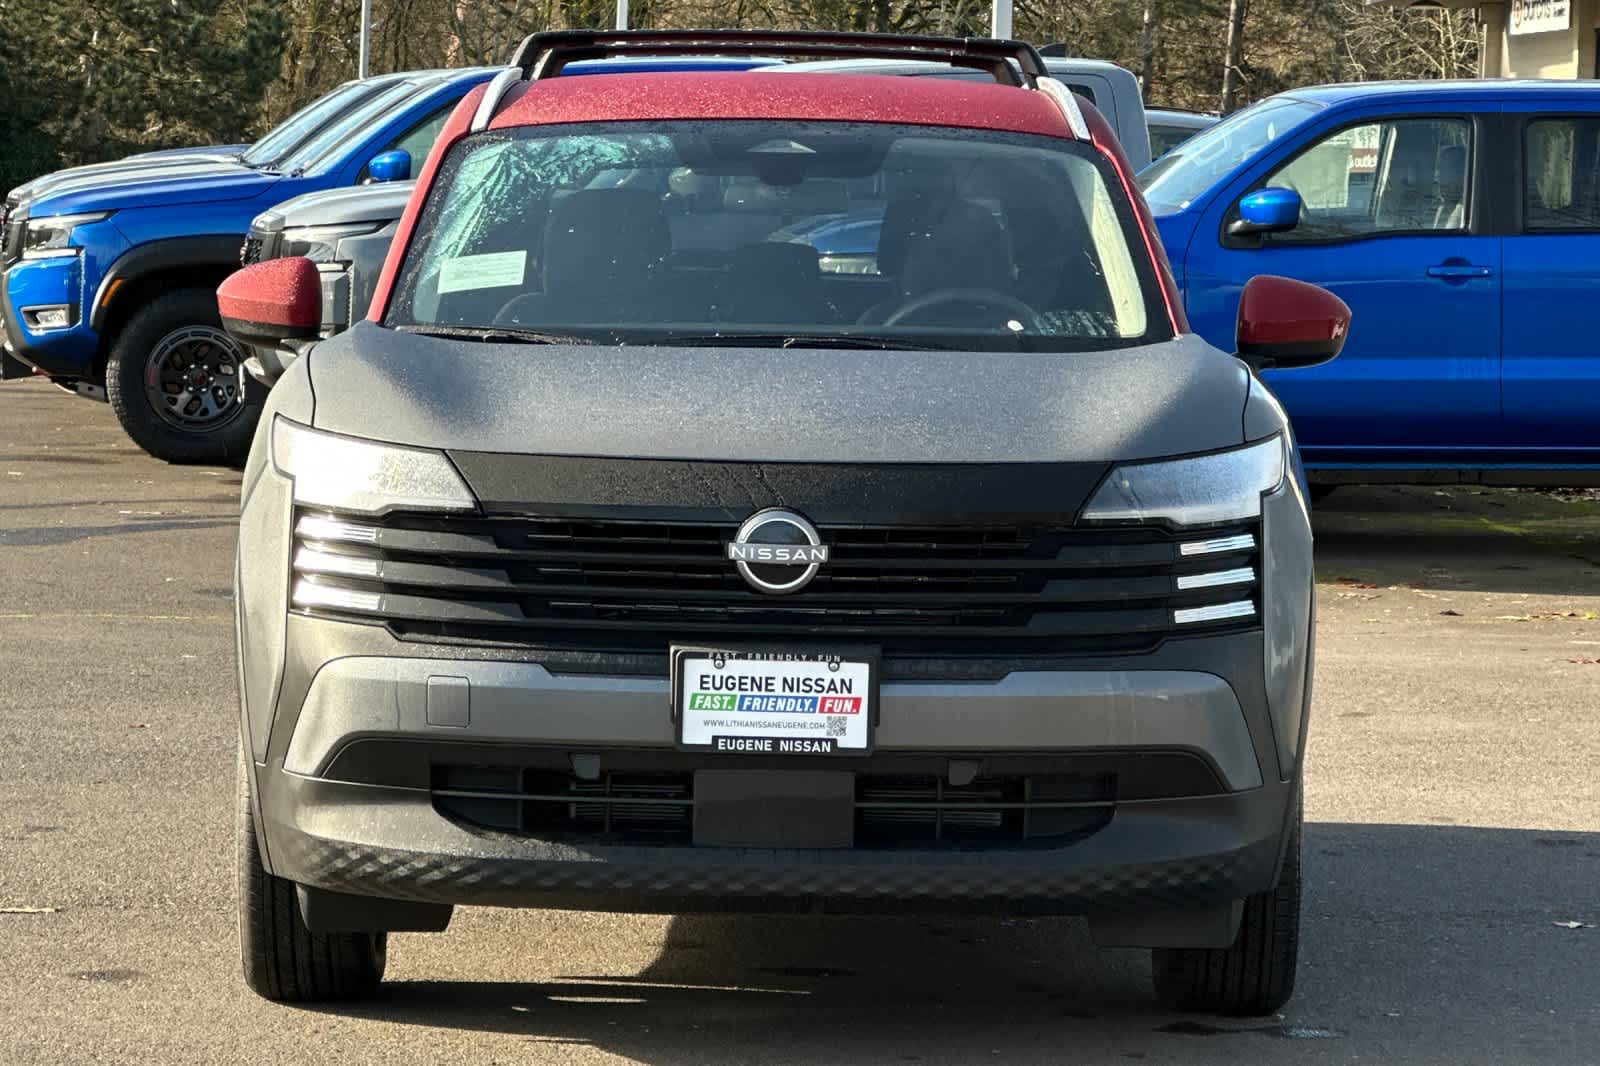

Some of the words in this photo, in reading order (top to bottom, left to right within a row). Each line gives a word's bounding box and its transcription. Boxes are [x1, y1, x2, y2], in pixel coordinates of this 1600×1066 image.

[731, 546, 826, 560] NISSAN
[700, 675, 776, 692] EUGENE
[782, 677, 852, 694] NISSAN
[694, 694, 732, 710] FAST.
[742, 696, 814, 712] FRIENDLY.
[823, 698, 857, 713] FUN.
[703, 719, 826, 730] WWW.LITHIANISSANEUGENE.COM
[717, 738, 773, 751] EUGENE
[779, 740, 831, 753] NISSAN
